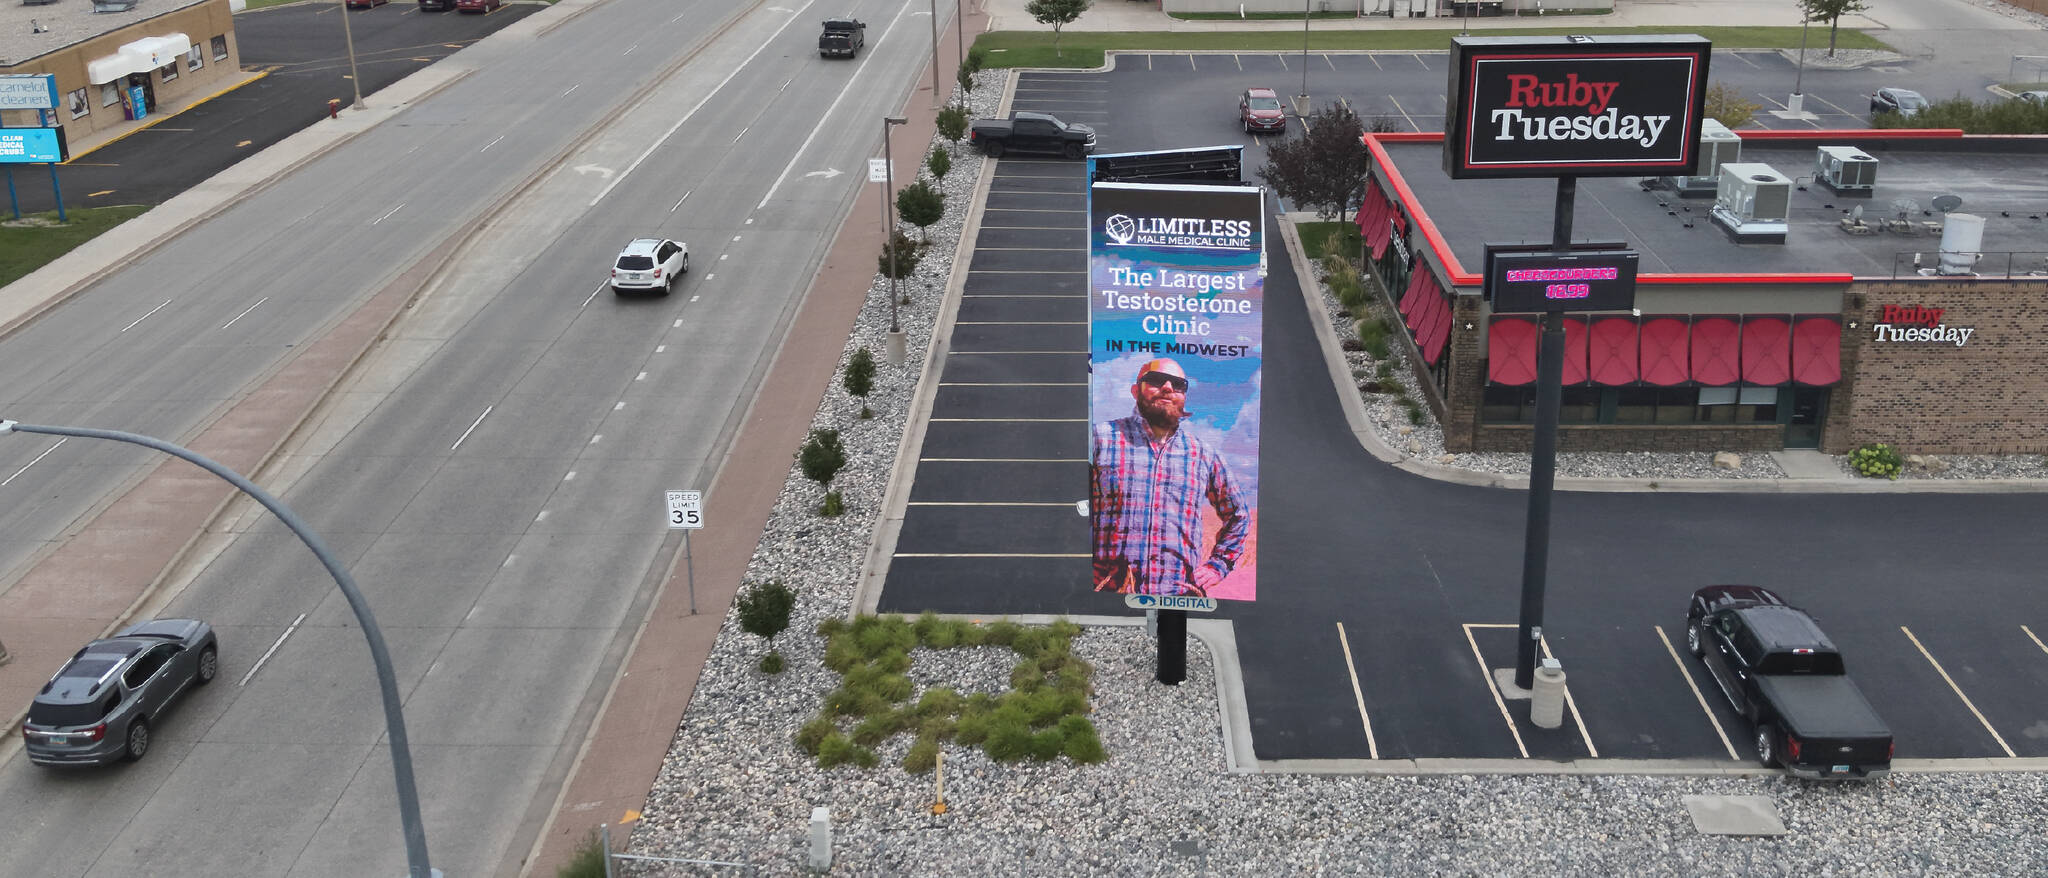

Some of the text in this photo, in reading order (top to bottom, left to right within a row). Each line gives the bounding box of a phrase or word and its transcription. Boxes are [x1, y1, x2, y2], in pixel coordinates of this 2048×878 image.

[1, 95, 49, 105] cleaners
[1505, 73, 1620, 115] Ruby
[1491, 107, 1671, 148] Tuesday
[0, 141, 24, 149] EDICAL
[0, 148, 25, 156] CRUBS
[1137, 217, 1251, 238] LIMITLESS
[1137, 235, 1251, 247] MALE MEDICAL CLINIC
[1109, 267, 1246, 294] The Largest
[1102, 290, 1252, 314] Testosterone
[1142, 315, 1211, 336] Clinic
[1882, 303, 1946, 328] Ruby
[1873, 323, 1975, 347] Tuesday
[1106, 339, 1249, 357] IN THE MIDWEST
[672, 510, 699, 524] 35
[1160, 596, 1213, 609] iDIGITAL
